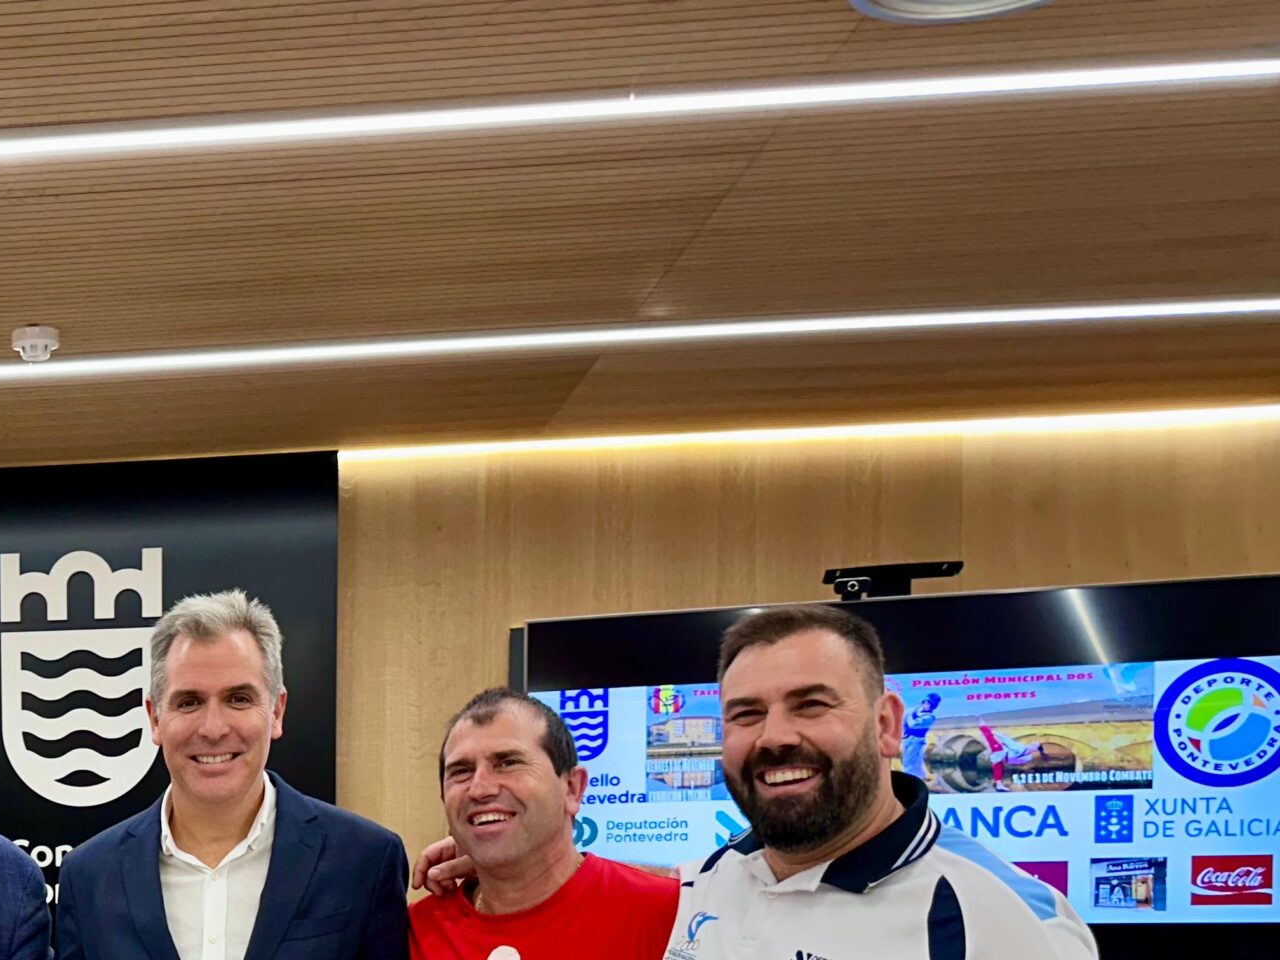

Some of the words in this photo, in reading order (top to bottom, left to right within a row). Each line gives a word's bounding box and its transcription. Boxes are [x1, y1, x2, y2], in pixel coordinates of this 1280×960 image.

[1182, 676, 1275, 706] DEPORTE
[1173, 724, 1280, 771] PONTEVEDRA
[581, 791, 647, 804] tevedra
[1145, 797, 1233, 815] XUNTA
[606, 818, 688, 832] Deputación
[1143, 821, 1175, 838] DE
[1185, 818, 1280, 837] GALICIA
[606, 830, 688, 842] Pontevedra
